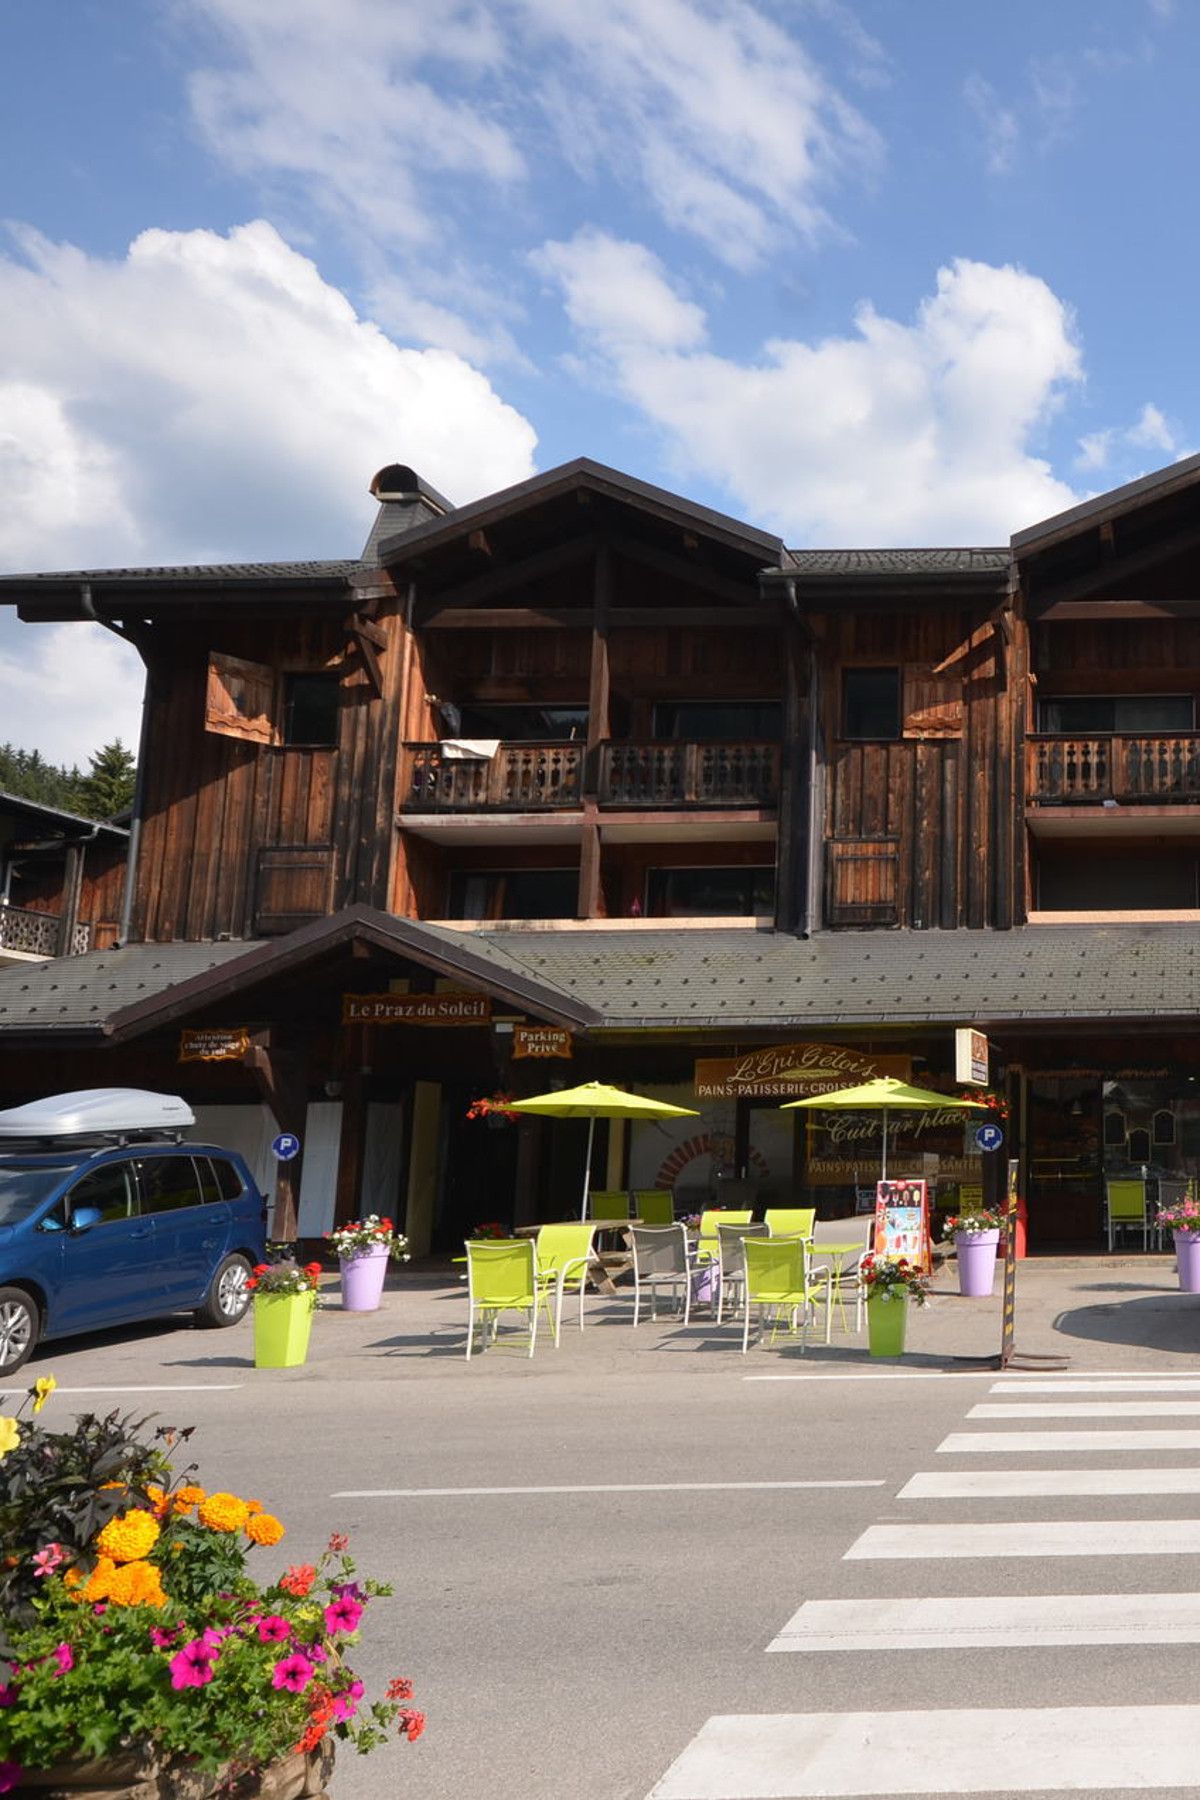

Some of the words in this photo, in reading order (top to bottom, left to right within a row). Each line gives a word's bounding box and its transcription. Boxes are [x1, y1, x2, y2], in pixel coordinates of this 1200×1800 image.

[350, 1003, 370, 1017] Le
[374, 1003, 414, 1017] Praz
[417, 1004, 436, 1016] du
[438, 1001, 485, 1017] Soleil
[520, 1031, 566, 1043] Parking
[984, 1129, 995, 1141] P
[280, 1137, 293, 1151] P
